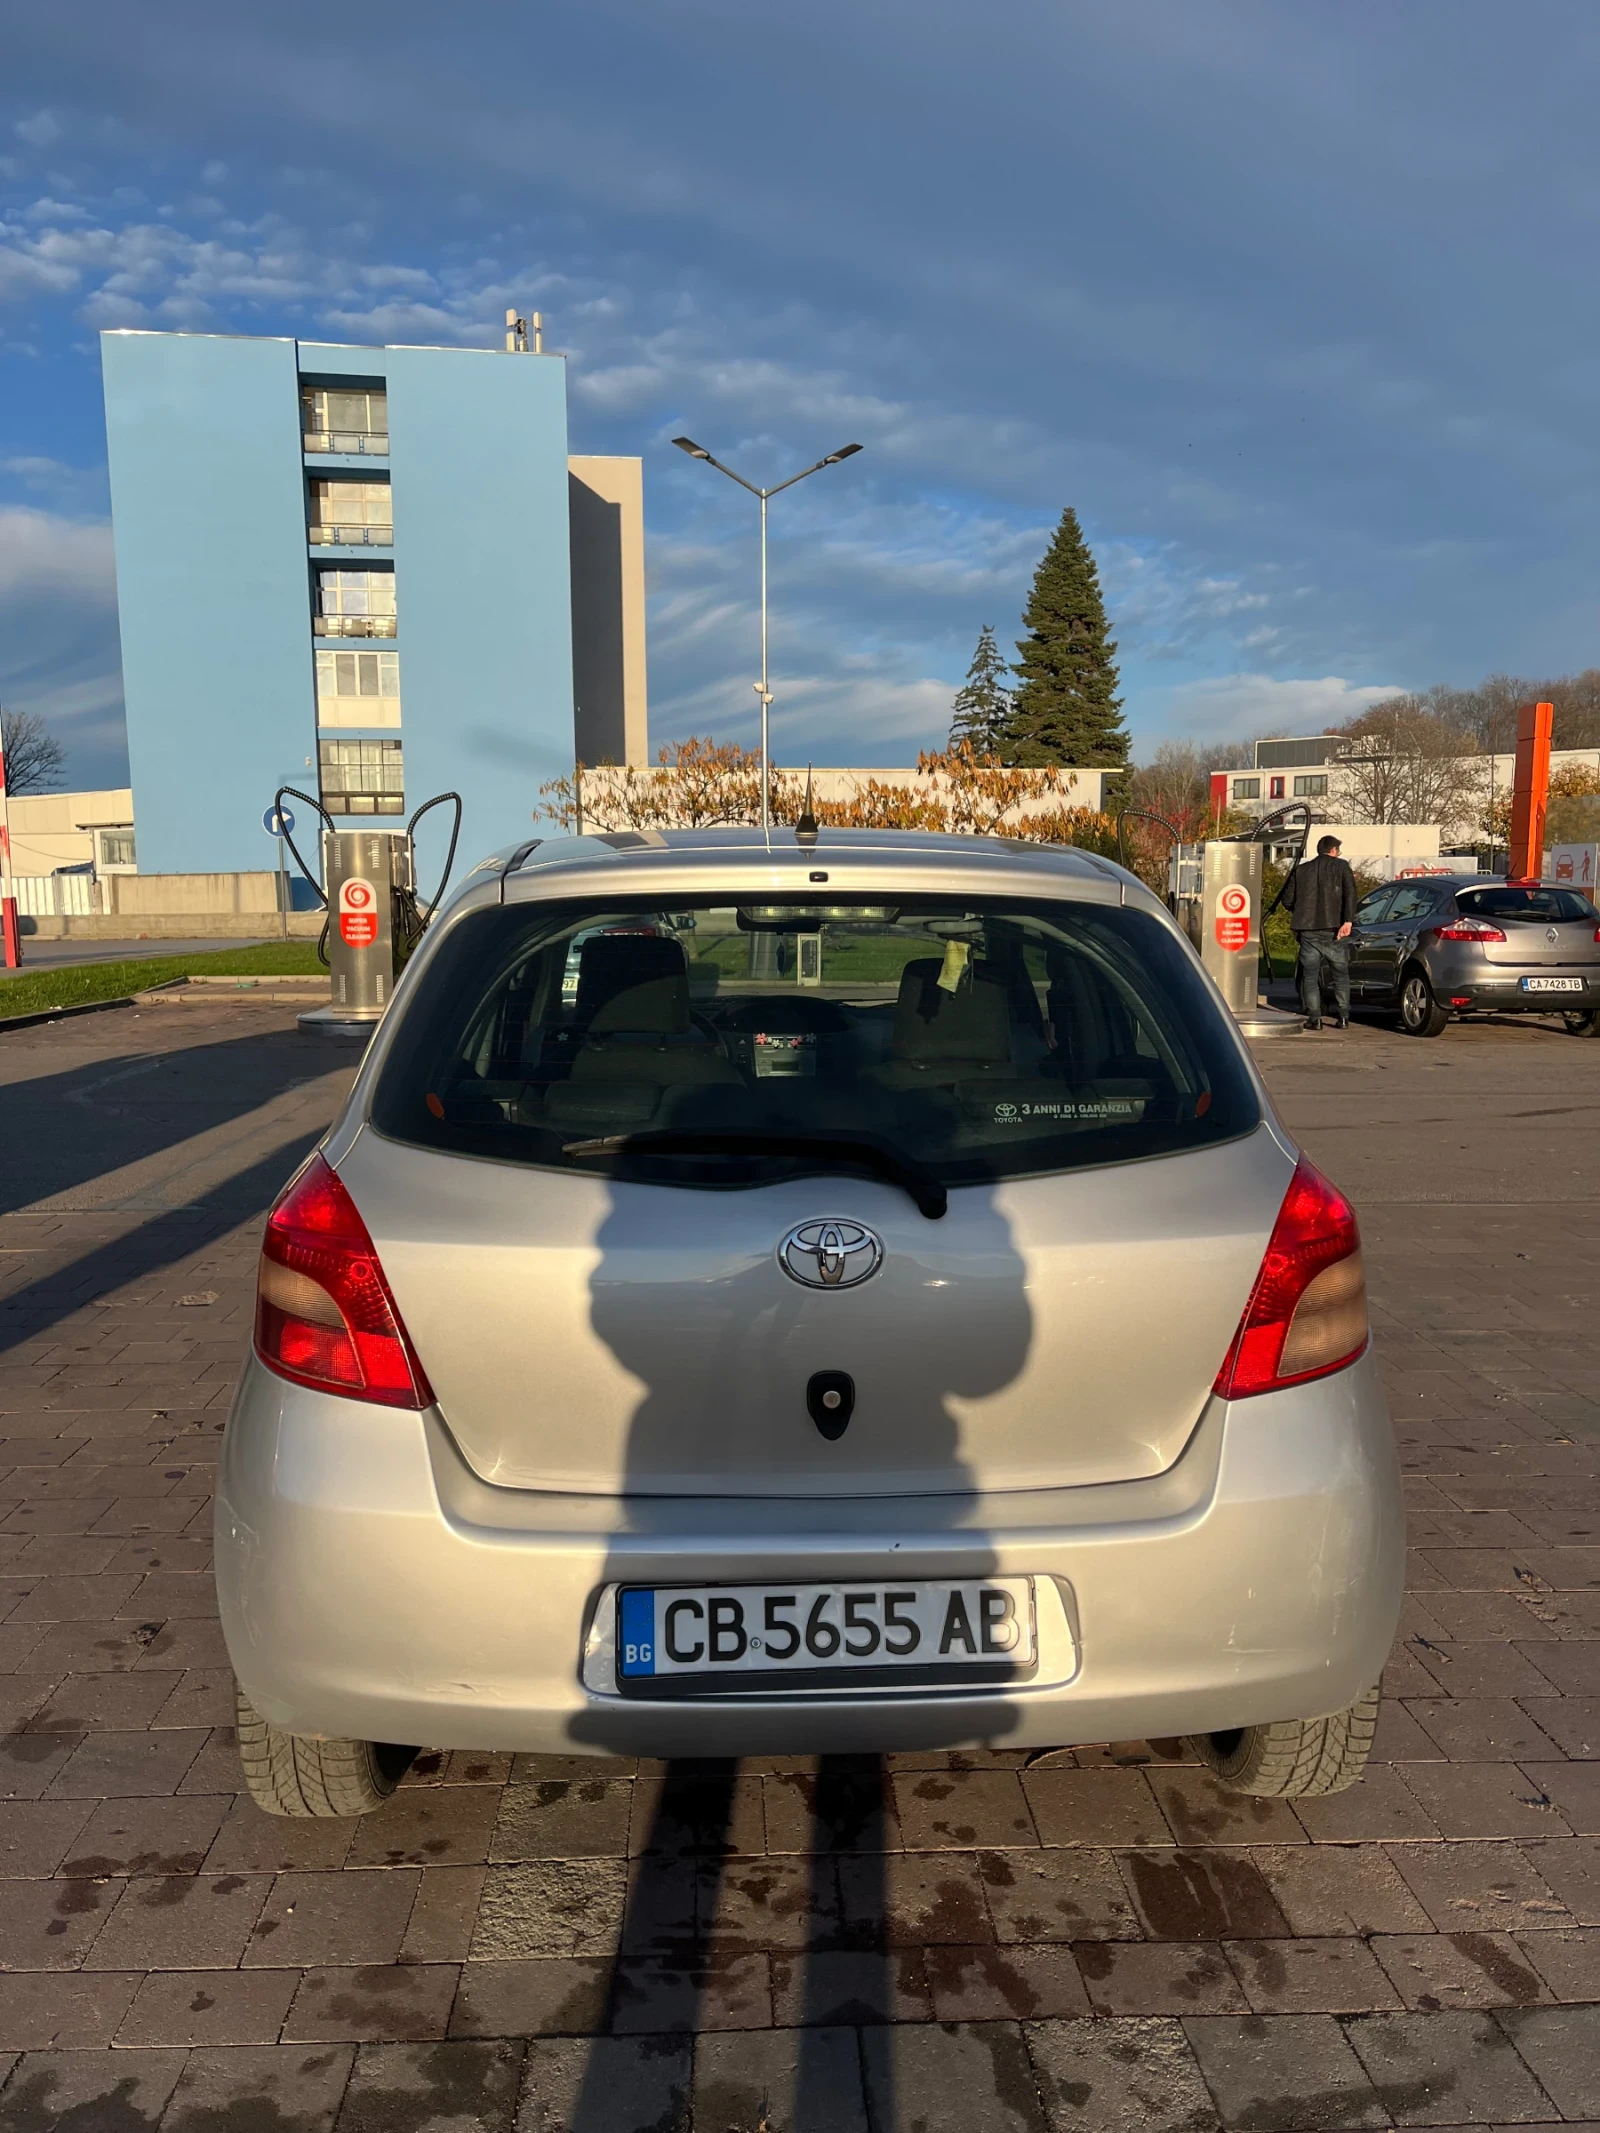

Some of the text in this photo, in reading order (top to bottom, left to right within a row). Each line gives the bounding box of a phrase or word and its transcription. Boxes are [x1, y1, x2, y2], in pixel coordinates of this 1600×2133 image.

[1529, 979, 1543, 989] CA
[1544, 979, 1567, 989] 7428
[1567, 979, 1581, 989] TB
[1021, 1103, 1132, 1115] 3 ANNI DI GARANZIA
[665, 1589, 1020, 1663] CB 5655 AB
[625, 1643, 652, 1664] BG
